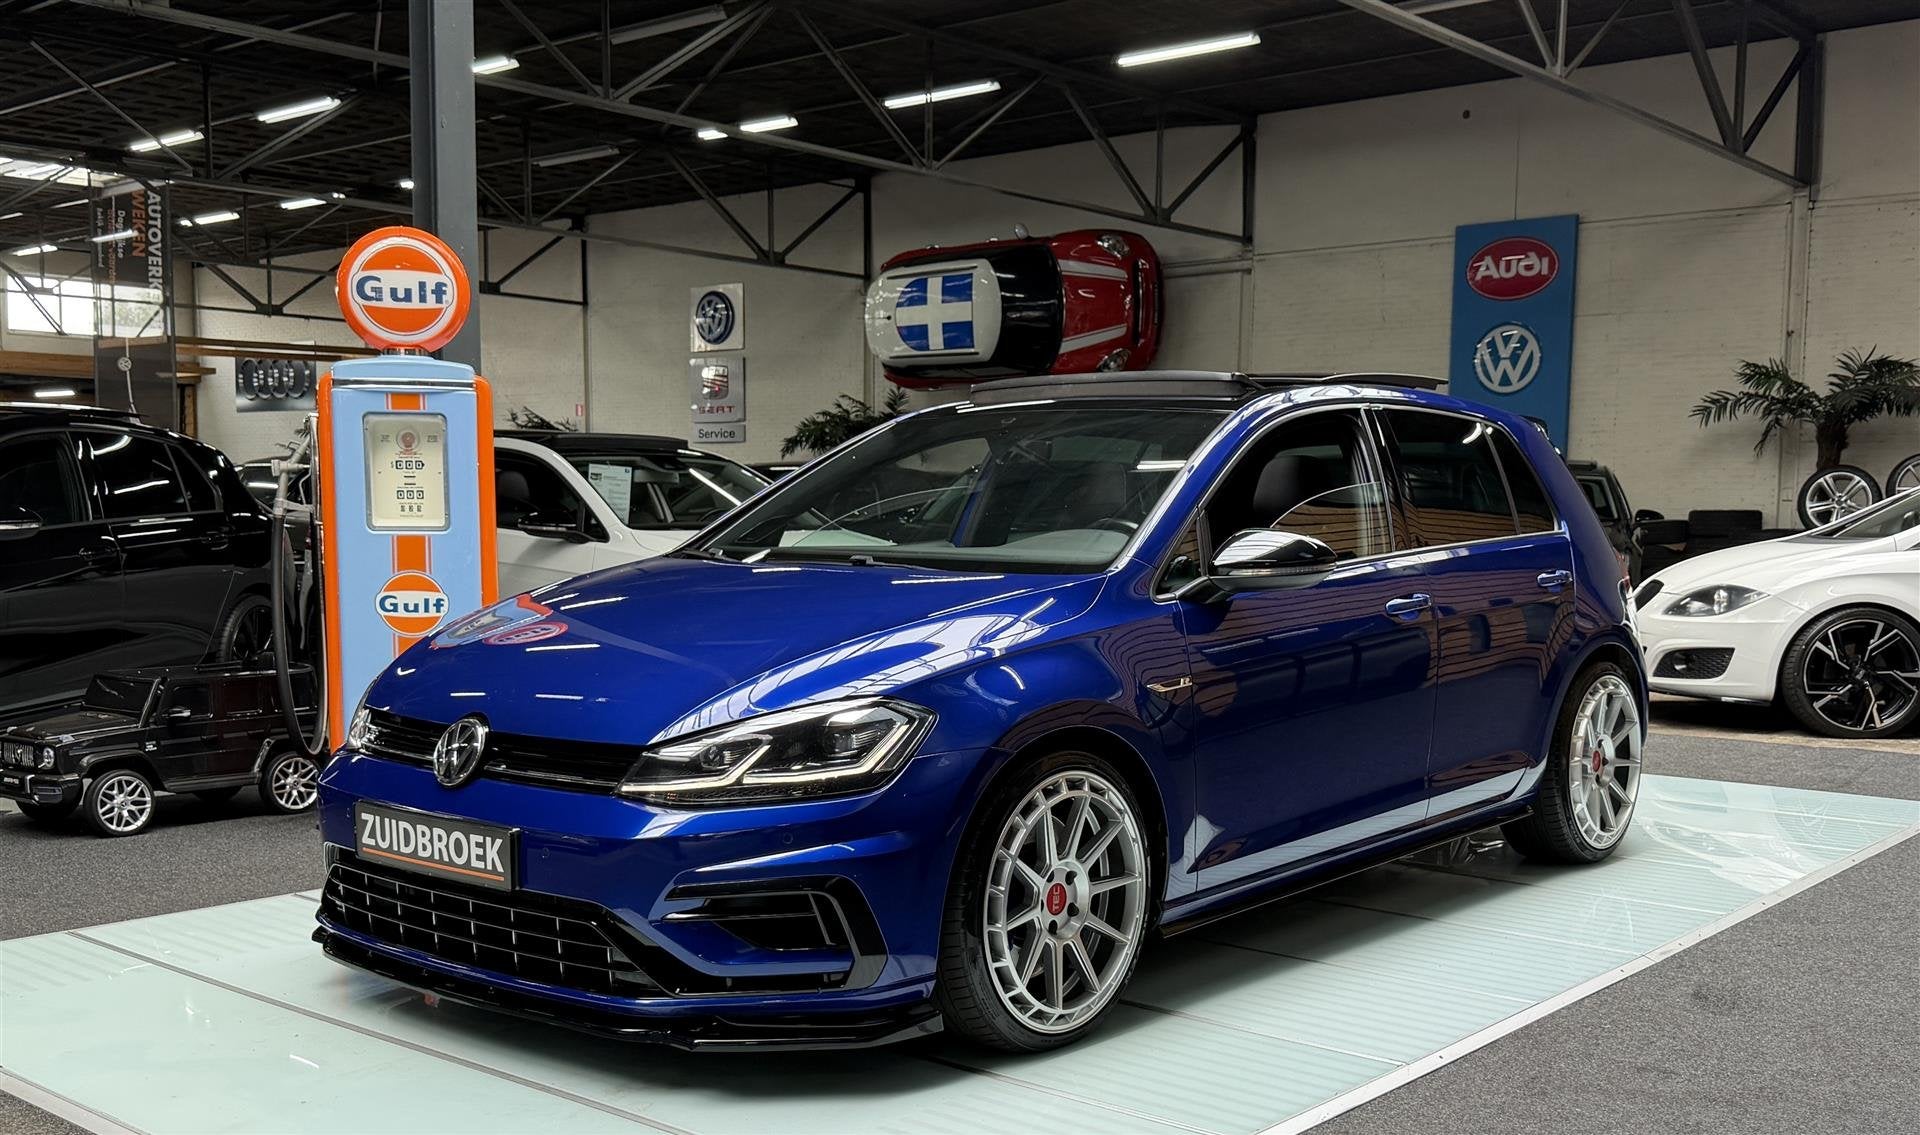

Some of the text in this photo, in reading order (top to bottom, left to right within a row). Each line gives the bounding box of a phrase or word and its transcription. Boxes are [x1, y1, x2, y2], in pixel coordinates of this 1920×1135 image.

[131, 189, 146, 257] WEKEN
[356, 275, 448, 304] Gulf
[698, 405, 736, 415] SEAT
[698, 428, 736, 439] Service
[379, 595, 445, 613] Gulf
[361, 812, 505, 873] ZUIDBROEK
